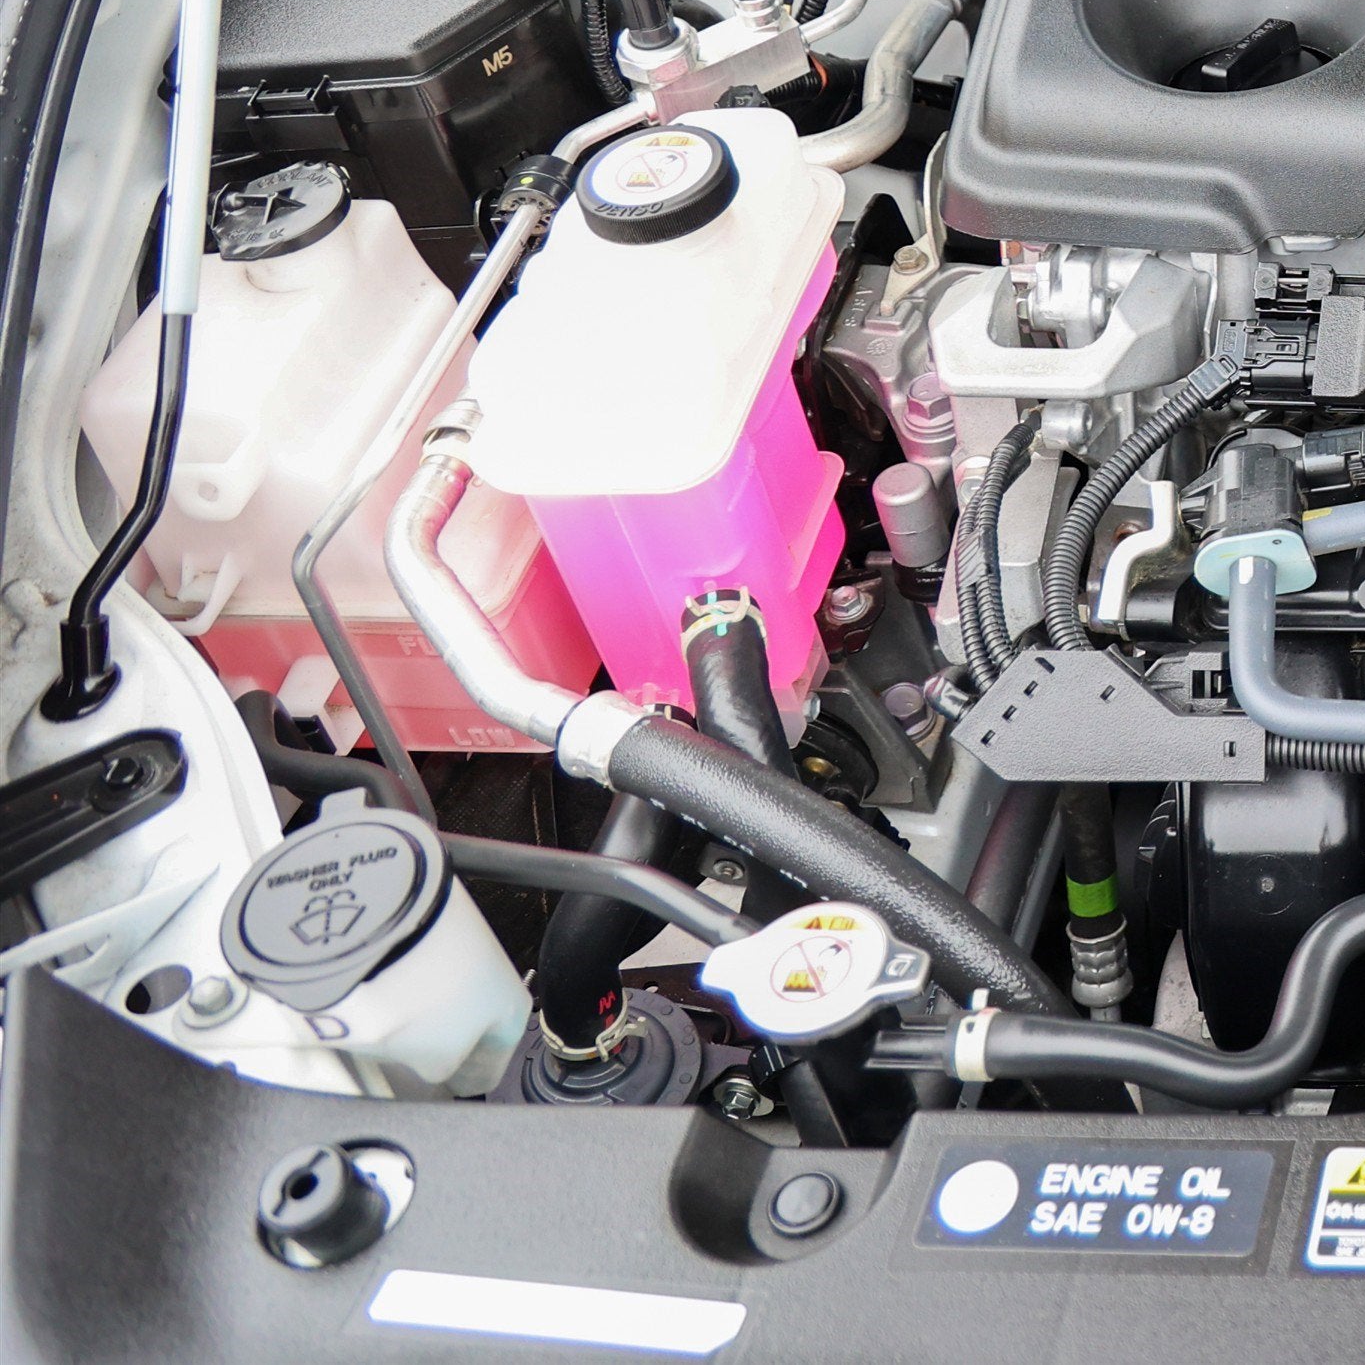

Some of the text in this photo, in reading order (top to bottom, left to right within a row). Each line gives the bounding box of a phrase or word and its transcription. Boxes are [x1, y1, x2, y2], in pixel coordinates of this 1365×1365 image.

[481, 44, 513, 77] M5
[594, 201, 664, 217] DENSO
[448, 727, 516, 747] LOW
[347, 847, 398, 868] FLUID
[309, 871, 353, 891] ONLY
[1039, 1163, 1231, 1199] ENGINE OIL
[1030, 1201, 1216, 1237] SAE 0W-8
